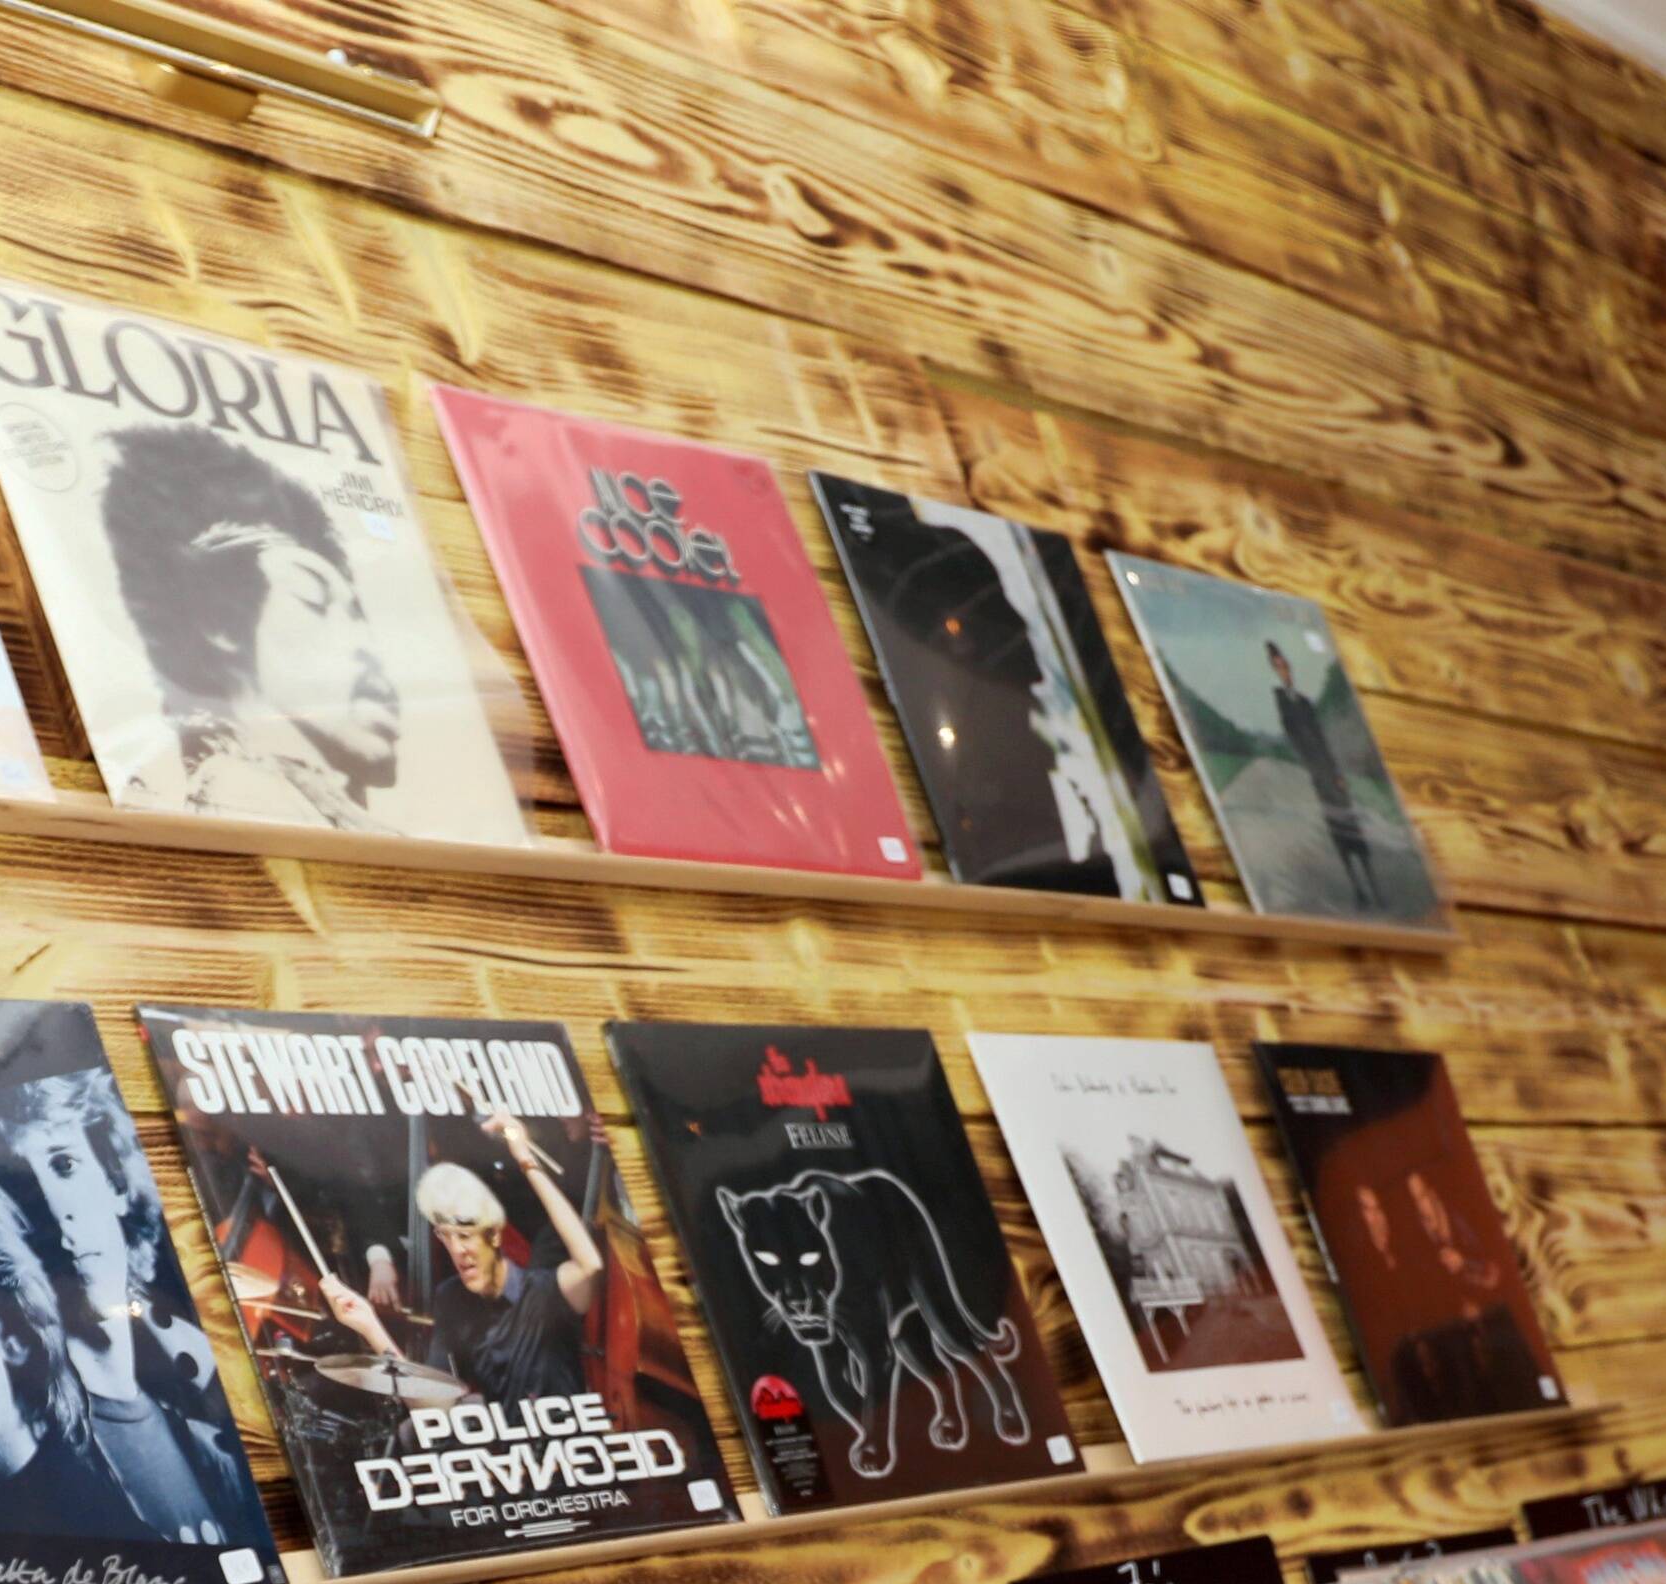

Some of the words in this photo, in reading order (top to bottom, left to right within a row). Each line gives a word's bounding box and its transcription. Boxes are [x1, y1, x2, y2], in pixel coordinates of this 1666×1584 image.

[171, 1029, 387, 1116] STEWART
[374, 1036, 584, 1118] COPELAND
[411, 1394, 613, 1450] POLICE
[451, 1506, 497, 1529] FOR
[501, 1490, 632, 1523] ORCHESTRA
